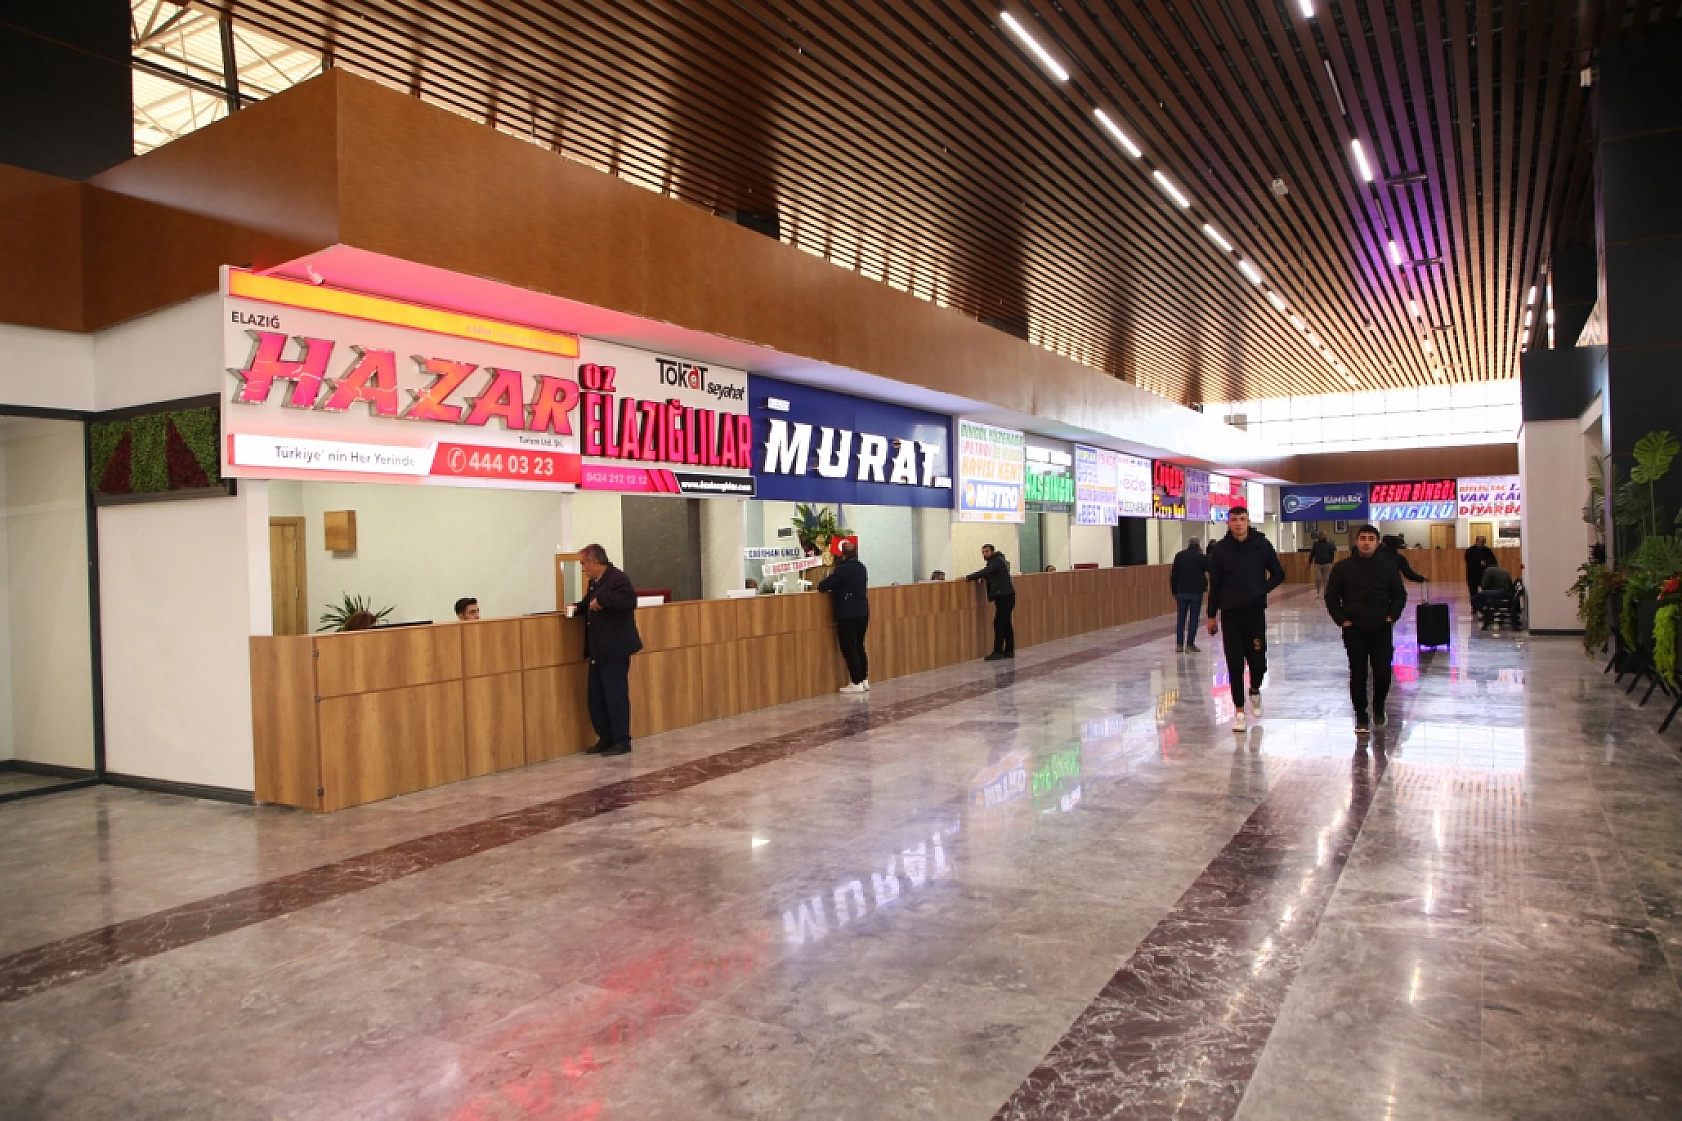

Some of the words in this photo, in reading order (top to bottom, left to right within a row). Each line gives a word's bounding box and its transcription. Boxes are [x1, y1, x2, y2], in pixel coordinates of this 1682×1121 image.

[231, 311, 280, 329] ELAZIĞ
[228, 329, 580, 436] HAZAR
[580, 362, 617, 393] ÖZ
[707, 382, 745, 400] seyahat
[580, 391, 752, 469] ELAZIĞLILAR
[328, 449, 347, 462] nin
[350, 451, 371, 464] Her
[374, 452, 415, 467] Yerinde
[764, 418, 941, 487] MURAT
[469, 453, 503, 472] 444
[508, 455, 529, 473] 03
[533, 457, 554, 475] 23
[976, 484, 1018, 511] METRO
[1460, 493, 1489, 502] VAN
[1370, 501, 1455, 520] VANGÖLÜ
